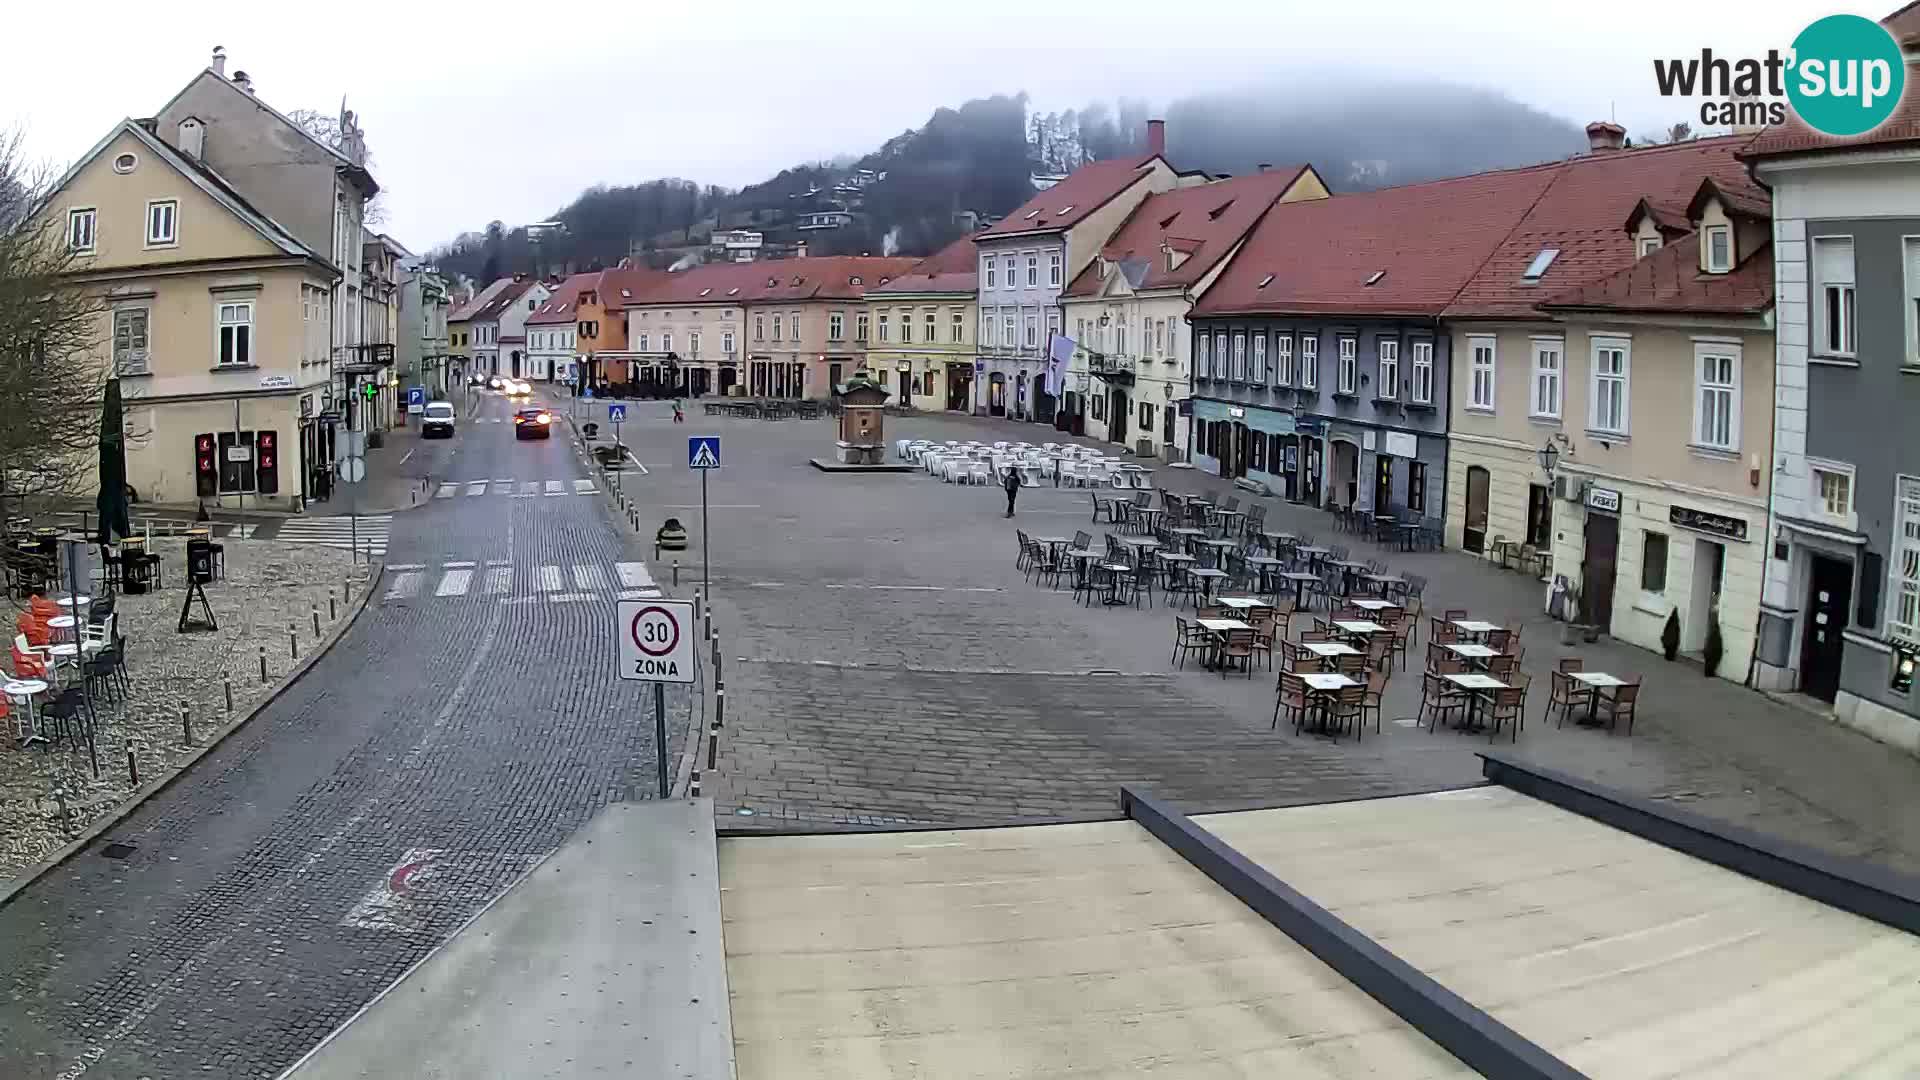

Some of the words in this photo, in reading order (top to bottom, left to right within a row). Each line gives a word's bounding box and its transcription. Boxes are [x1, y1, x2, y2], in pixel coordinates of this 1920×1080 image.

[411, 391, 420, 402] P
[644, 622, 668, 643] 30
[635, 659, 679, 677] ZONA
